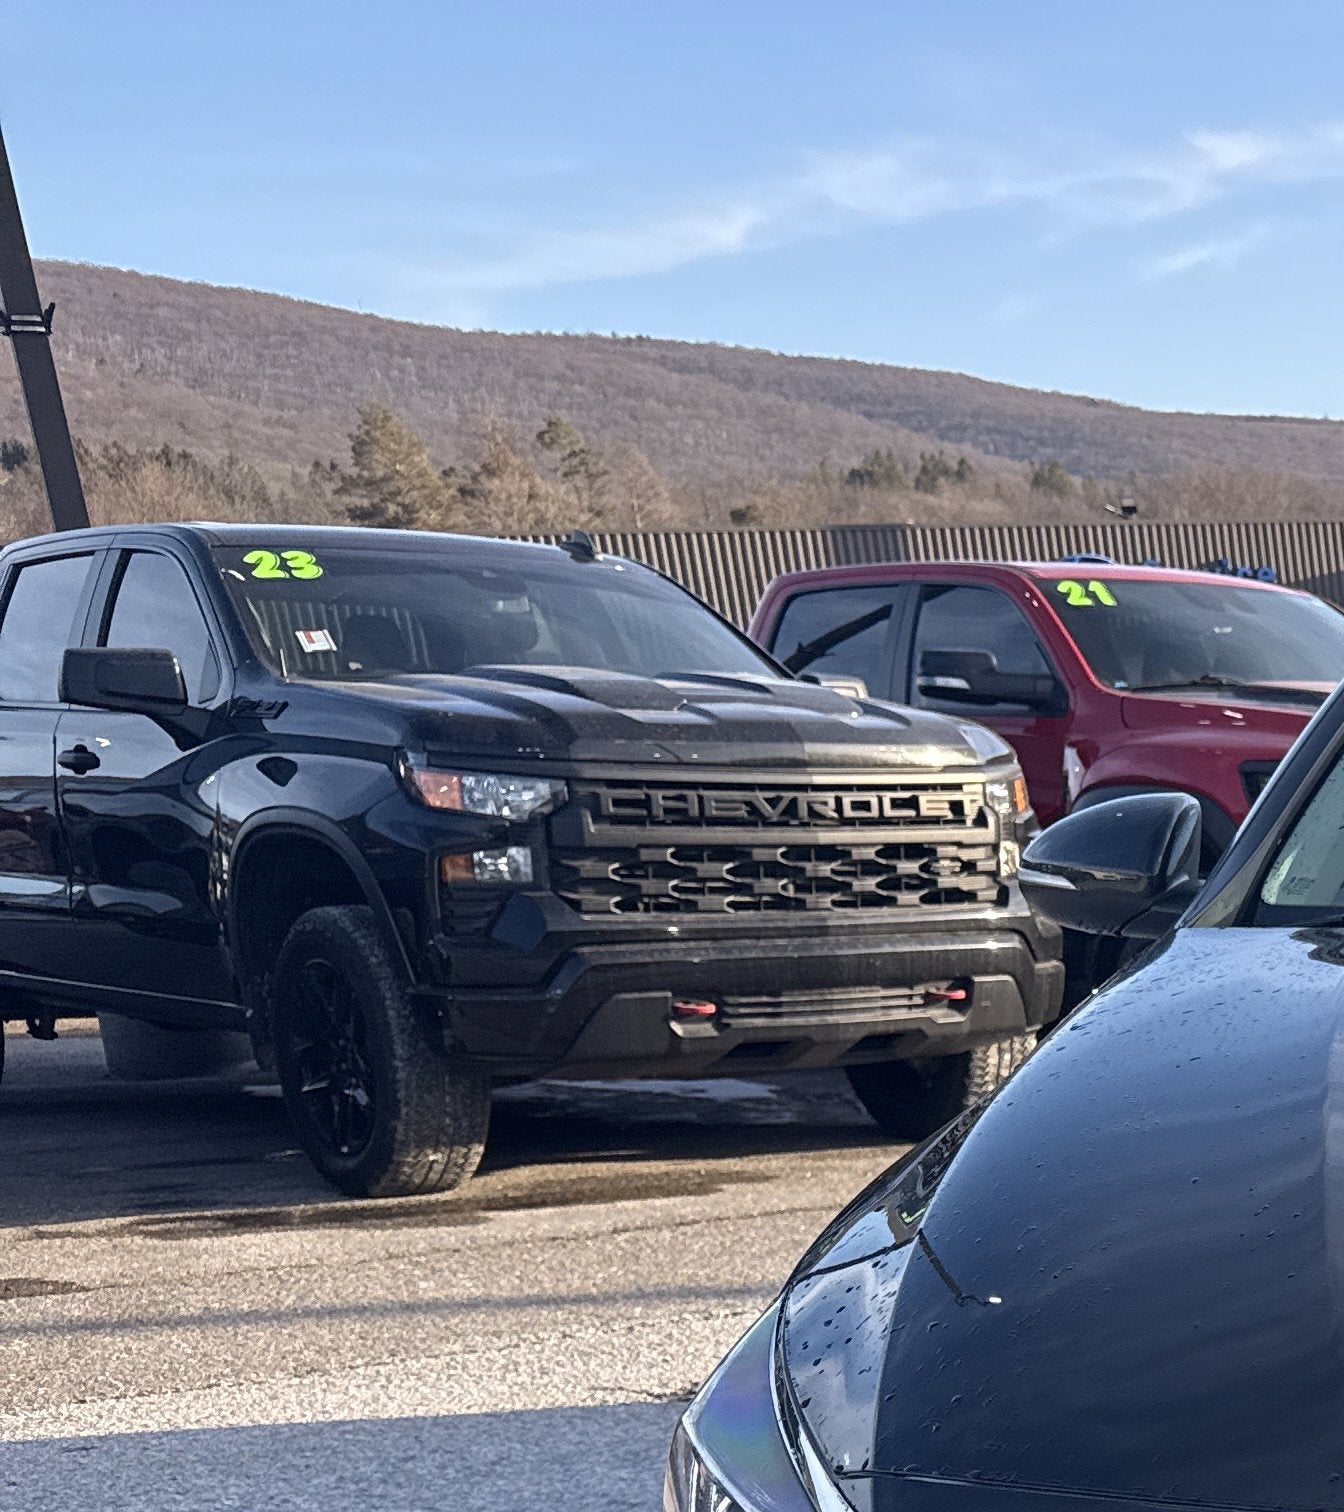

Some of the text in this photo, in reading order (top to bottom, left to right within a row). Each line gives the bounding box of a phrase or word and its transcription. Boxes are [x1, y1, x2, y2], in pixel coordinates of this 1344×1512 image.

[243, 549, 324, 579] 23
[1057, 580, 1118, 606] 21
[602, 790, 983, 825] CHEVROLET
